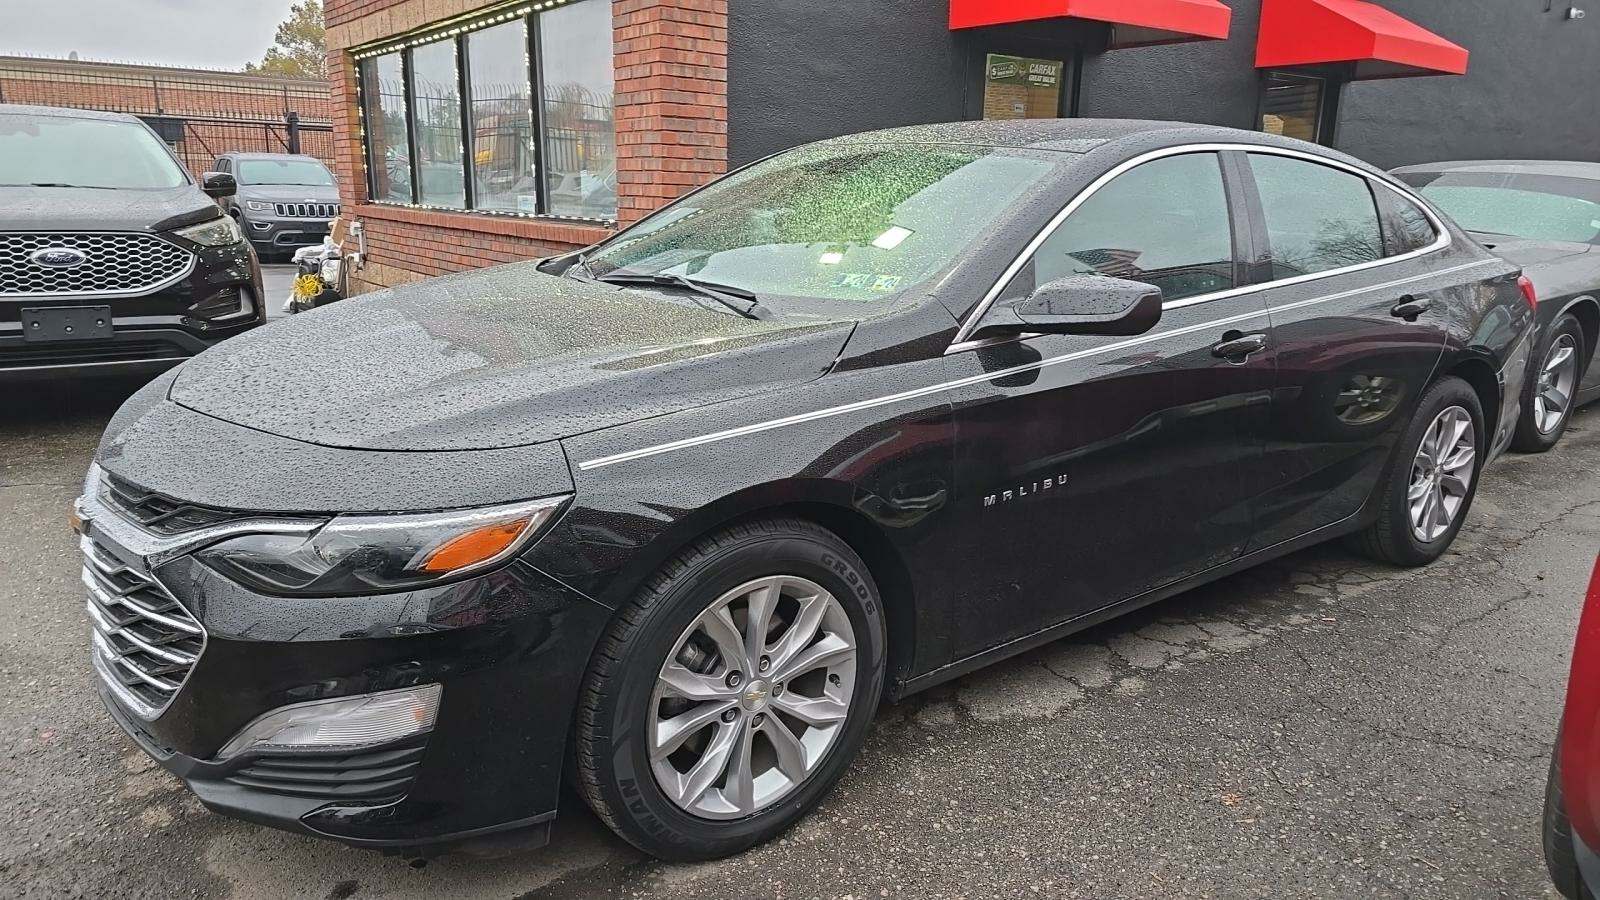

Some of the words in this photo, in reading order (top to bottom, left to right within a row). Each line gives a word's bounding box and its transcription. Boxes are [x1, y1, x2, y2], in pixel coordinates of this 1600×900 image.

[1029, 63, 1057, 76] CARFAX
[45, 252, 73, 263] Ford
[983, 474, 1068, 507] MALIBU
[821, 552, 876, 616] GR906
